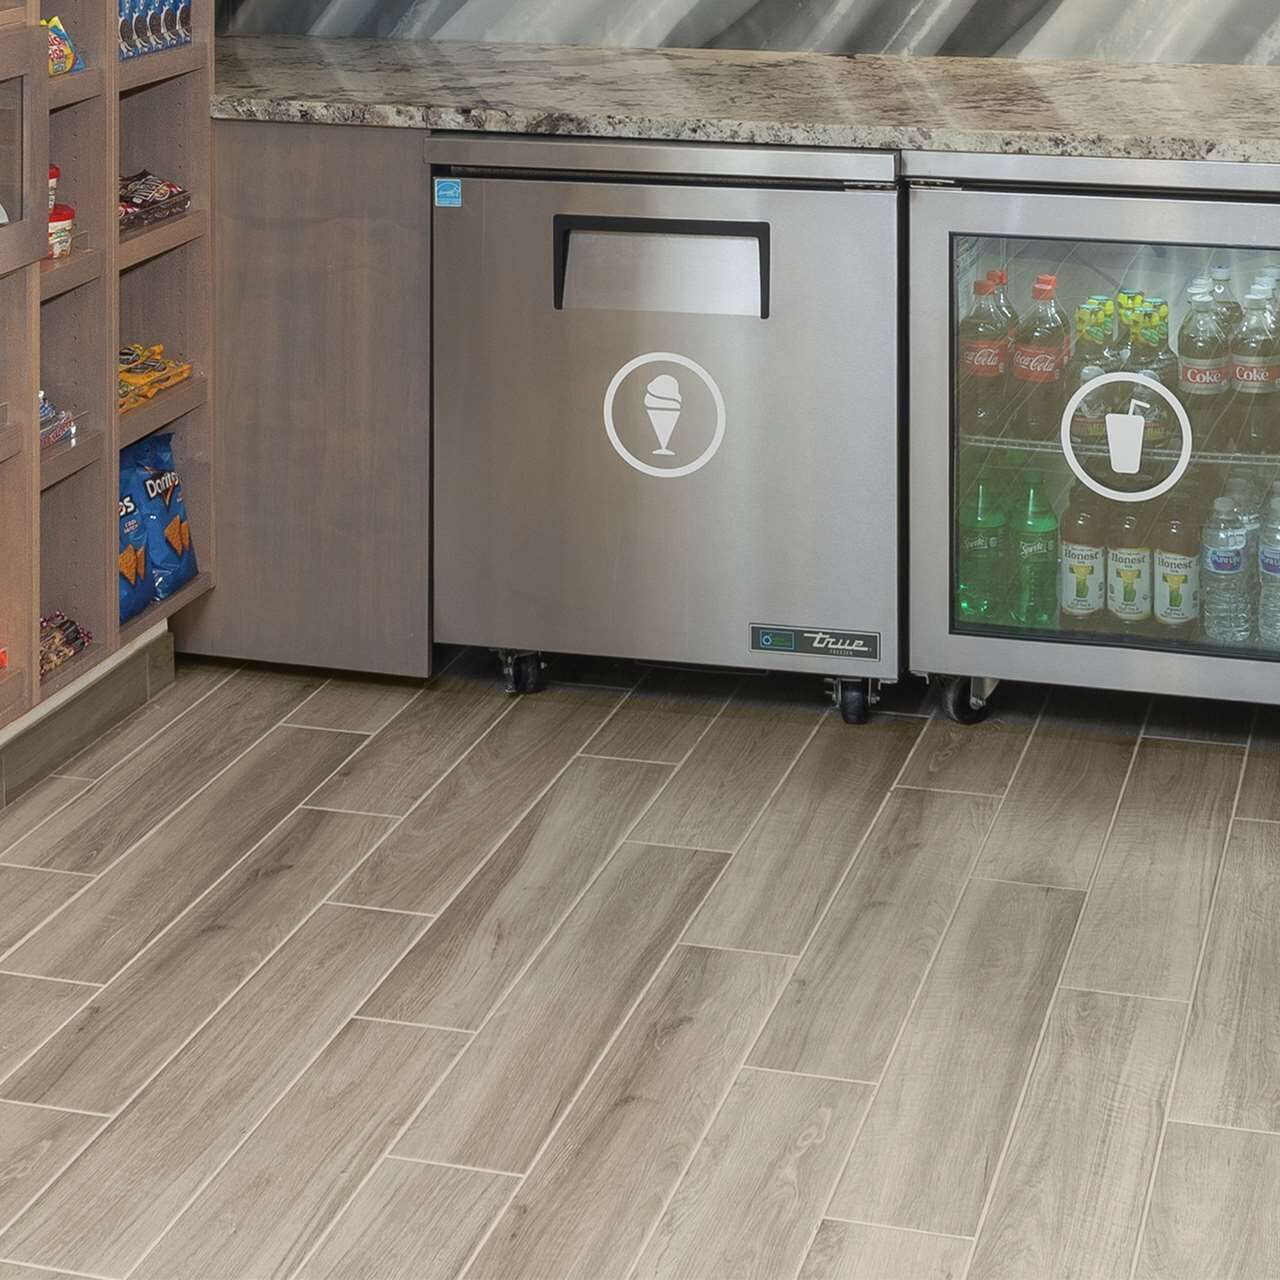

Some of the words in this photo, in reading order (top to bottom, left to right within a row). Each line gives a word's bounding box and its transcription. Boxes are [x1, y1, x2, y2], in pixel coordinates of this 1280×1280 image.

[1187, 369, 1222, 385] Coke
[1235, 365, 1270, 382] Coke
[1064, 548, 1099, 561] Honest
[1111, 552, 1146, 564] Honest
[1157, 556, 1193, 570] Honest
[803, 631, 869, 652] true
